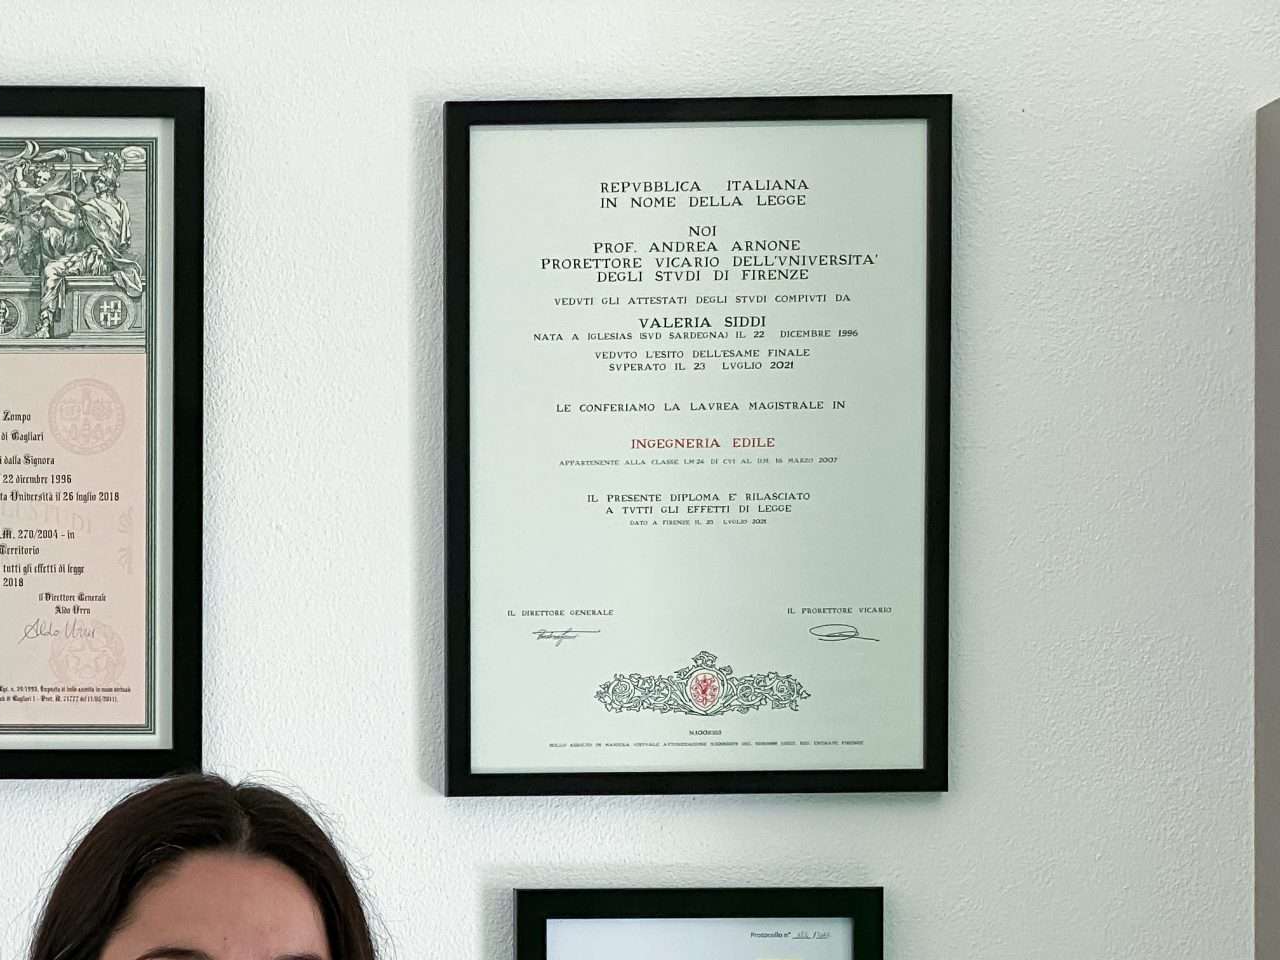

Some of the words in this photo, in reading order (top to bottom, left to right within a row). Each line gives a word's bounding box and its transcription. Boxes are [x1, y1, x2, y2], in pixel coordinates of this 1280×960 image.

[601, 181, 702, 193] REPVBBLICA
[728, 179, 809, 191] ITALIANA
[601, 198, 617, 209] IN
[631, 196, 676, 208] NOME
[690, 196, 743, 208] DELLA
[758, 195, 806, 206] LEGGE
[690, 226, 716, 237] NOI
[593, 242, 637, 254] PROF.
[649, 241, 719, 253] ANDREA
[731, 240, 801, 252] ARNONE
[542, 257, 642, 270] PRORETTORE
[656, 257, 720, 268] VICARIO
[733, 254, 878, 267] DELL'VNIVERSITA'
[598, 271, 643, 283] DEGLI
[655, 270, 700, 282] STVDI
[713, 270, 729, 281] DI
[742, 269, 809, 281] FIRENZE
[555, 298, 594, 306] VEDVTI
[602, 297, 619, 305] GLI
[628, 296, 687, 305] ATTESTATI
[697, 296, 727, 304] DEGLI
[736, 296, 767, 304] STVDI
[775, 294, 827, 303] COMPIVTI
[836, 294, 851, 302] DA
[639, 317, 712, 329] VALERIA
[725, 316, 766, 328] SIDDI
[534, 334, 563, 342] NATA
[588, 332, 633, 341] IGLESIAS
[736, 331, 746, 339] IL
[754, 331, 765, 339] 22
[780, 330, 831, 338] DICEMBRE
[839, 329, 859, 337] 1996
[595, 351, 638, 360] VEDVTO
[768, 349, 810, 357] FINALE
[609, 363, 667, 372] SVPERATO
[675, 363, 686, 371] IL
[694, 363, 706, 371] 23
[722, 361, 762, 370] LVGLIO
[770, 361, 794, 370] 2021
[557, 404, 571, 413] LE
[579, 403, 655, 413] CONFERIAMO
[665, 403, 681, 411] LA
[691, 402, 740, 411] LAVREA
[749, 401, 824, 411] MAGISTRALE
[833, 401, 845, 410] IN
[3, 410, 31, 424] Zompo
[1, 432, 8, 441] di
[632, 438, 721, 449] INGEGNERIA
[733, 438, 775, 448] EDILE
[4, 456, 21, 465] dalla
[24, 454, 55, 467] Signora
[3, 474, 14, 484] 22
[16, 474, 48, 484] dicembre
[52, 474, 72, 485] 1996
[588, 495, 599, 503] IL
[608, 494, 662, 503] PRESENTE
[670, 494, 720, 502] DIPLOMA
[746, 492, 810, 501] RILASCIATO
[622, 506, 653, 515] TVTTI
[661, 506, 679, 514] GLI
[688, 505, 730, 514] EFFETTI
[739, 505, 749, 513] DI
[758, 505, 792, 513] LEGGE
[3, 577, 24, 588] 2018
